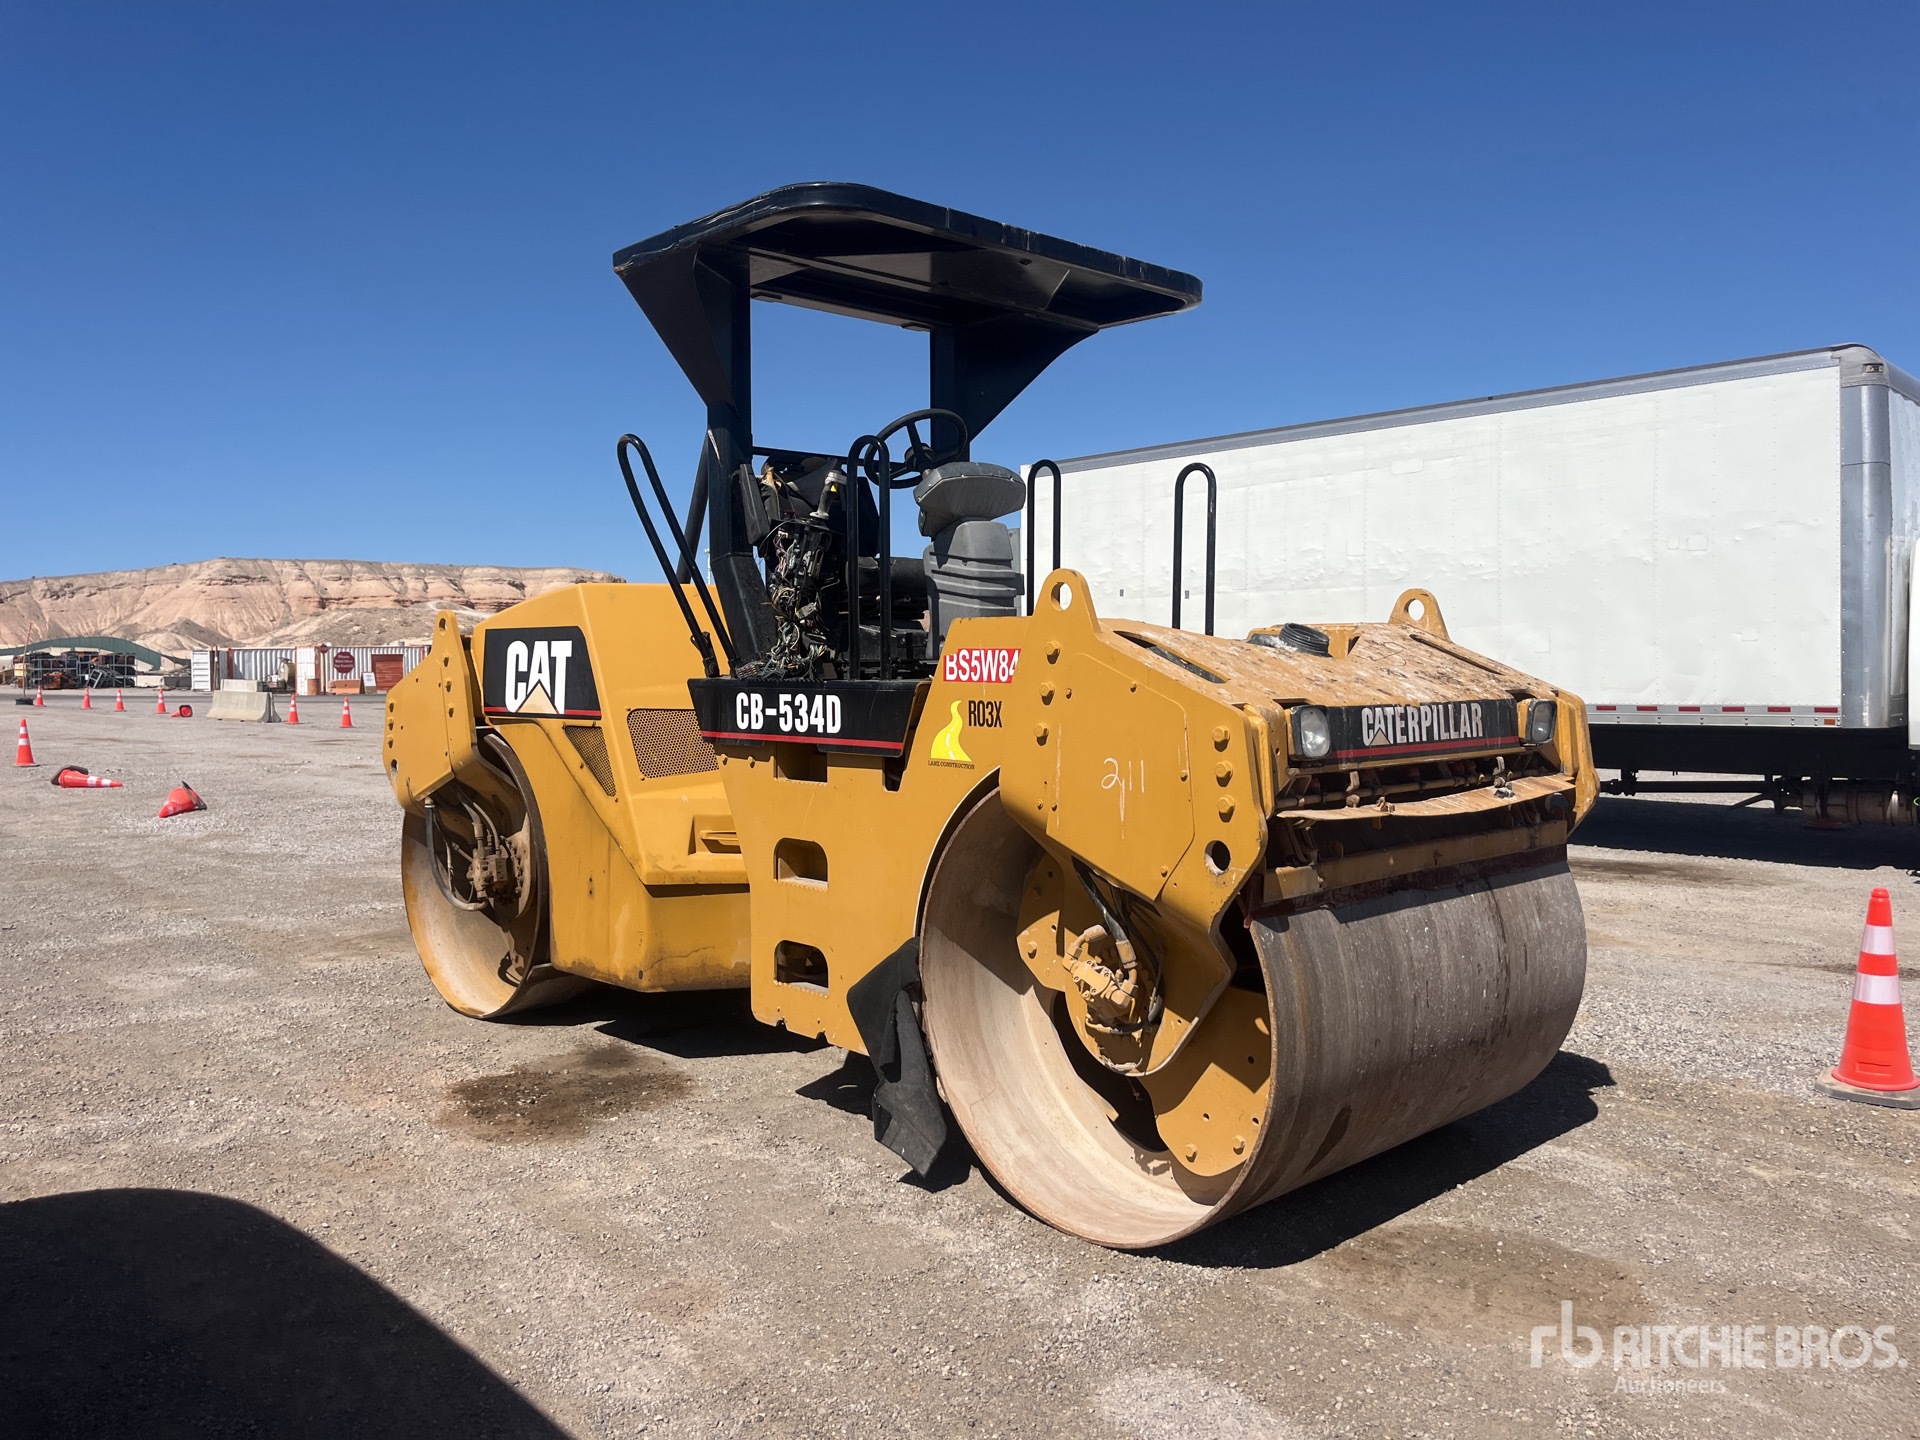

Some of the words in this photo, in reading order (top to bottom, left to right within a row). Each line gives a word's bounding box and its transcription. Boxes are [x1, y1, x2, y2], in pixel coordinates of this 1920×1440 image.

[505, 640, 572, 713] CAT
[945, 649, 1019, 682] BS5W84
[735, 691, 841, 734] CB-534D
[1361, 702, 1483, 747] CATERPILLAR
